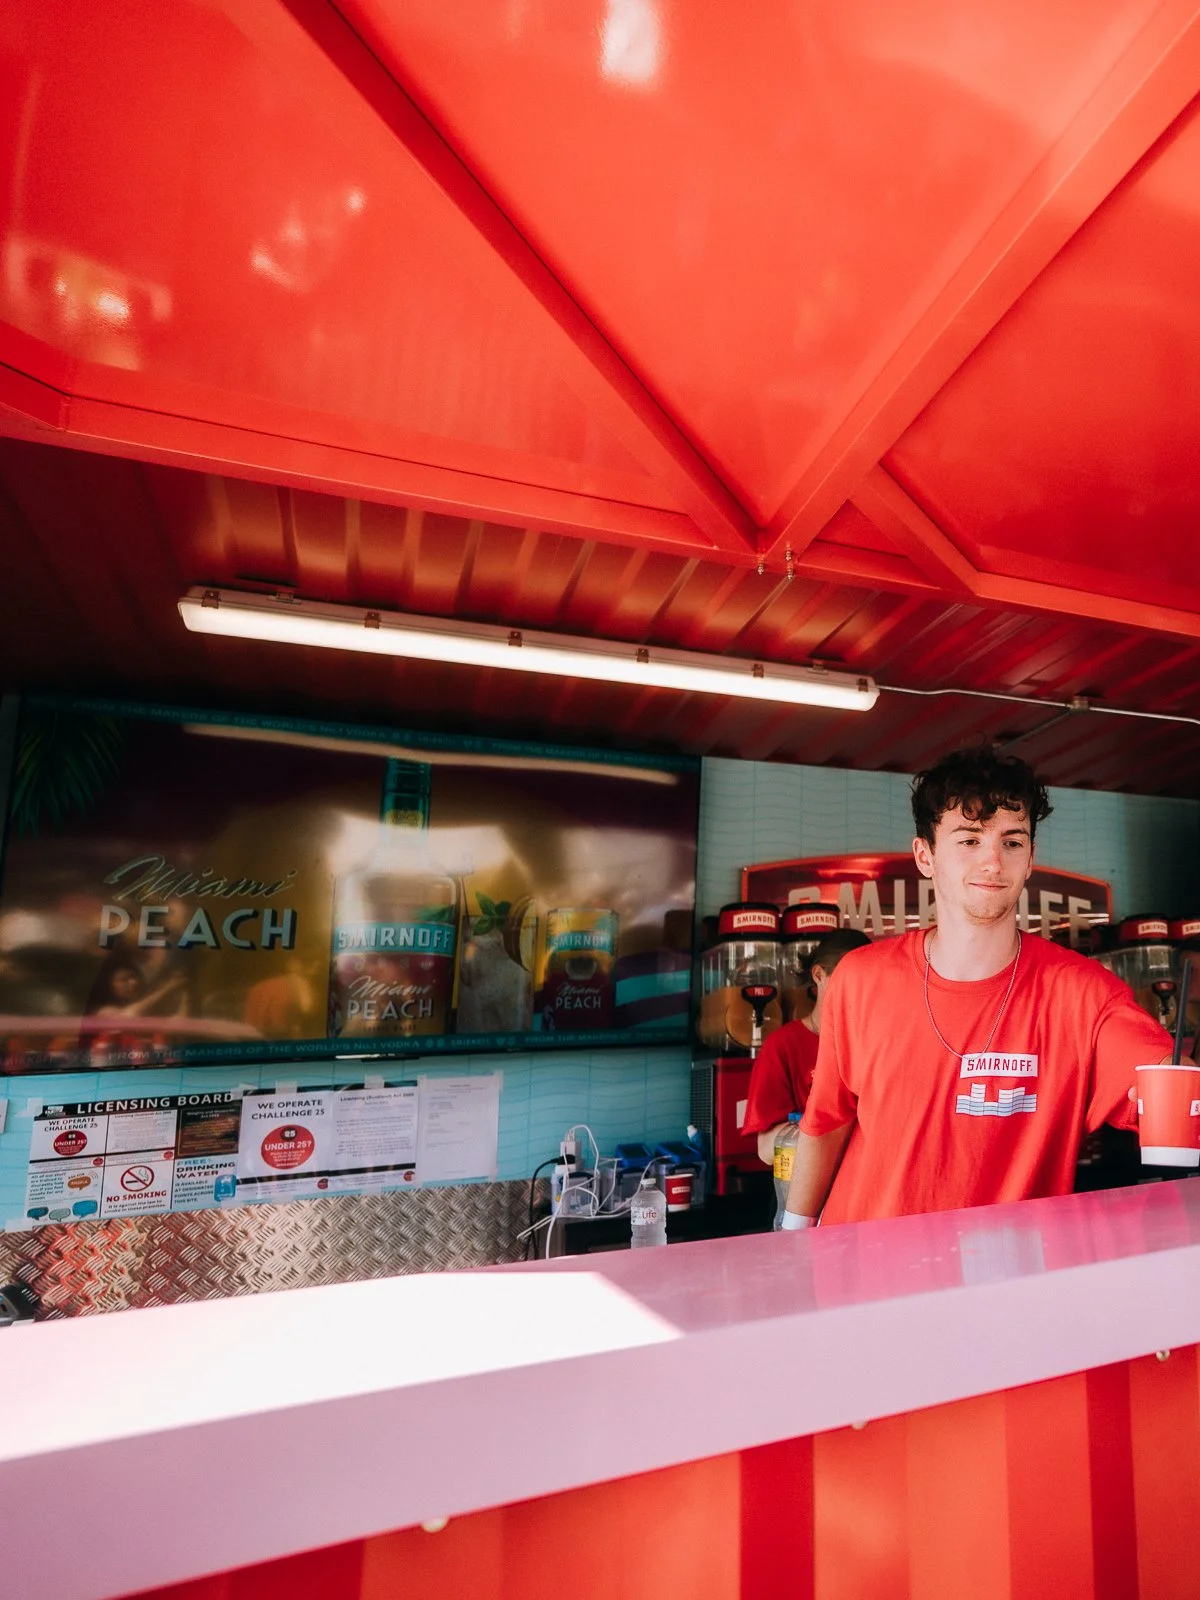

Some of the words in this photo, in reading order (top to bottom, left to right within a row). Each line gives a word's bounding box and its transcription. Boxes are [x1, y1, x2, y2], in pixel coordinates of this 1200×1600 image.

[120, 705, 147, 716] THE
[150, 708, 208, 722] MAKERS
[211, 714, 230, 724] OF
[234, 716, 258, 727] THE
[261, 718, 317, 732] WORLD'S
[345, 727, 386, 739] VODKA
[102, 853, 298, 902] Miami
[737, 913, 774, 925] SMIRNOFF
[800, 914, 836, 925] SMIRNOFF
[97, 904, 298, 950] PEACH
[338, 925, 452, 950] SMIRNOFF
[349, 975, 437, 999] Miami
[754, 987, 764, 996] PULL
[555, 995, 602, 1010] PEACH
[347, 998, 434, 1021] PEACH
[524, 1035, 554, 1044] FROM
[555, 1033, 576, 1042] THE
[107, 1049, 150, 1062] FROM
[154, 1047, 182, 1059] THE
[184, 1045, 243, 1058] MAKERS
[245, 1044, 263, 1055] OF
[266, 1043, 292, 1054] THE
[295, 1041, 351, 1053] WORLD'S
[353, 1040, 378, 1050] No.1
[380, 1039, 420, 1050] VODKA
[967, 1057, 1032, 1072] SMIRNOFF
[77, 1095, 171, 1115] LICENSING
[177, 1092, 234, 1106] BOARD
[257, 1102, 275, 1110] WE
[277, 1099, 323, 1109] OPERATE
[251, 1108, 313, 1120] CHALLENGE
[62, 1117, 95, 1125] OPERATE
[44, 1123, 88, 1132] CHALLENGE
[284, 1130, 296, 1138] 25
[54, 1139, 77, 1147] UNDER
[264, 1141, 295, 1151] UNDER
[297, 1140, 312, 1149] 25?
[176, 1161, 236, 1173] DRINKING
[176, 1170, 219, 1179] WATER
[106, 1195, 120, 1203] NO
[122, 1190, 167, 1201] SMOKING
